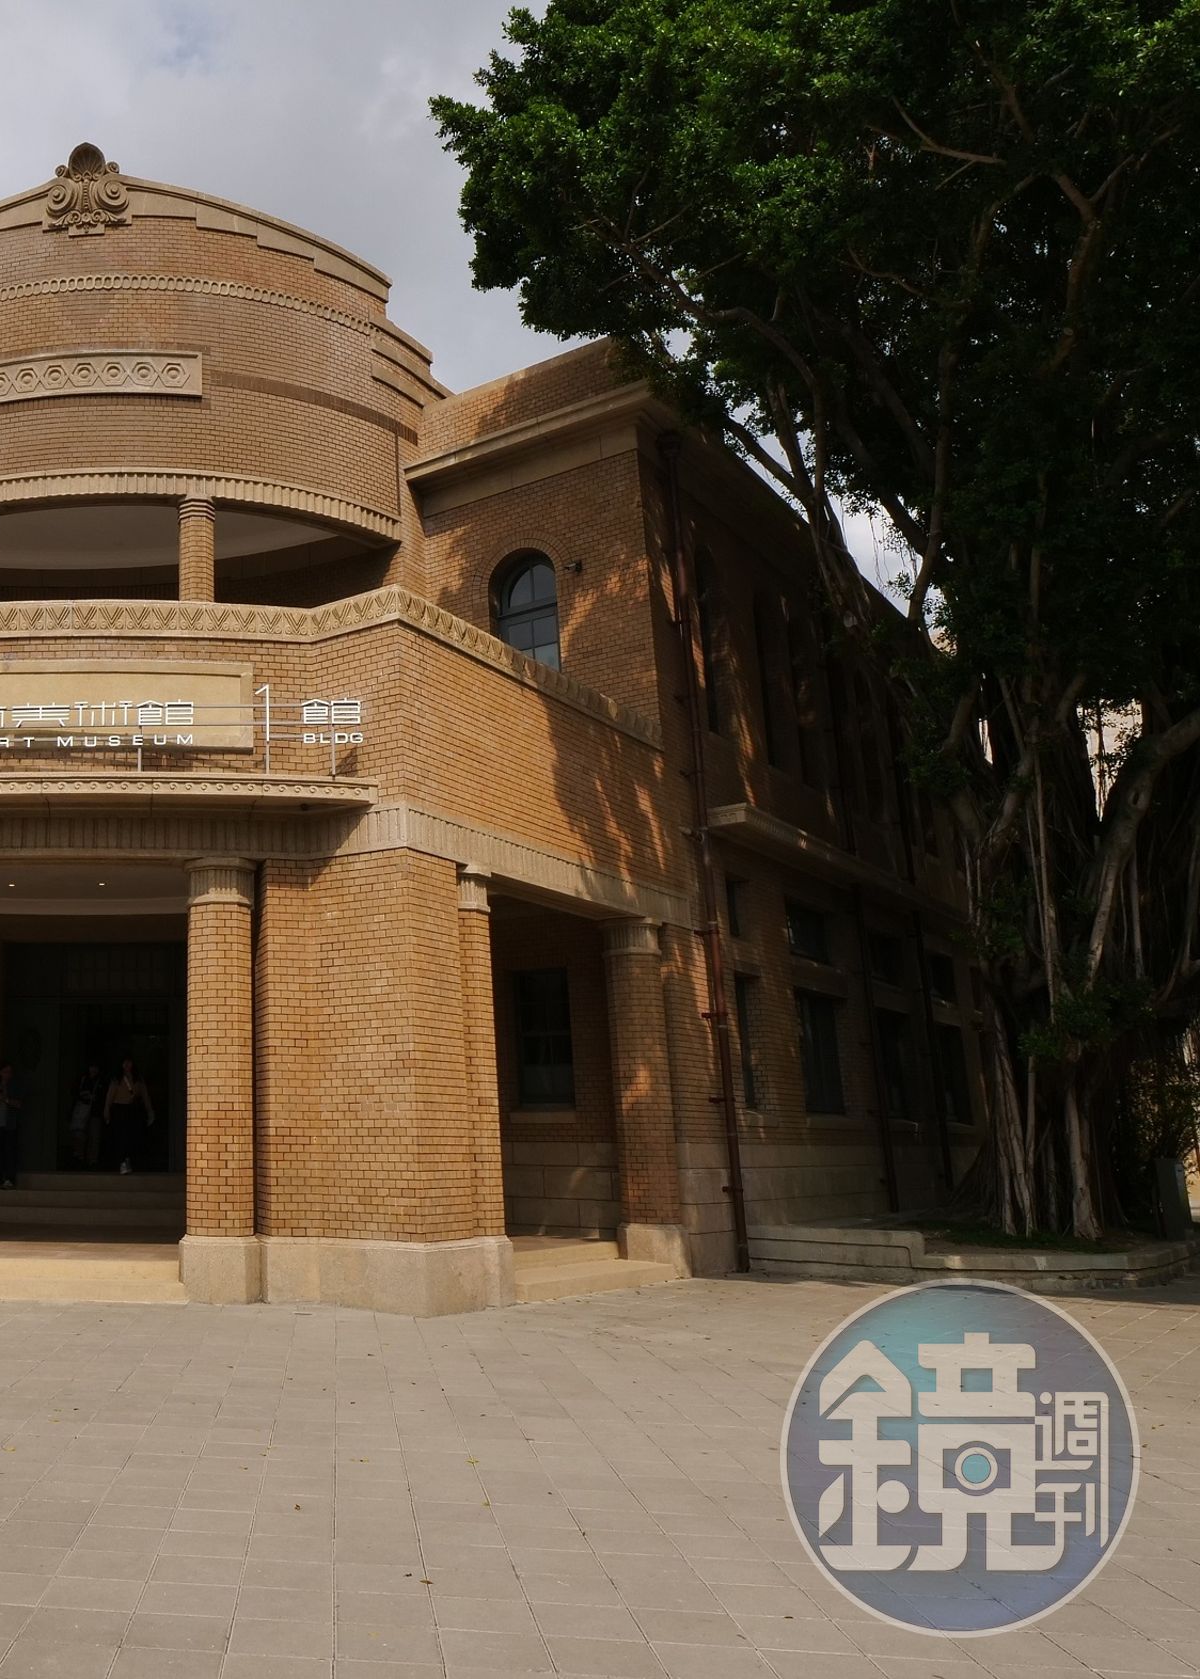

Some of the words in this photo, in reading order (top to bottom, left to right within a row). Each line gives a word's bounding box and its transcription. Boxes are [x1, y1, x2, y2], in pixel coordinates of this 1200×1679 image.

[301, 697, 361, 725] 館
[57, 734, 193, 747] MUSEUM
[302, 732, 364, 744] BLDG
